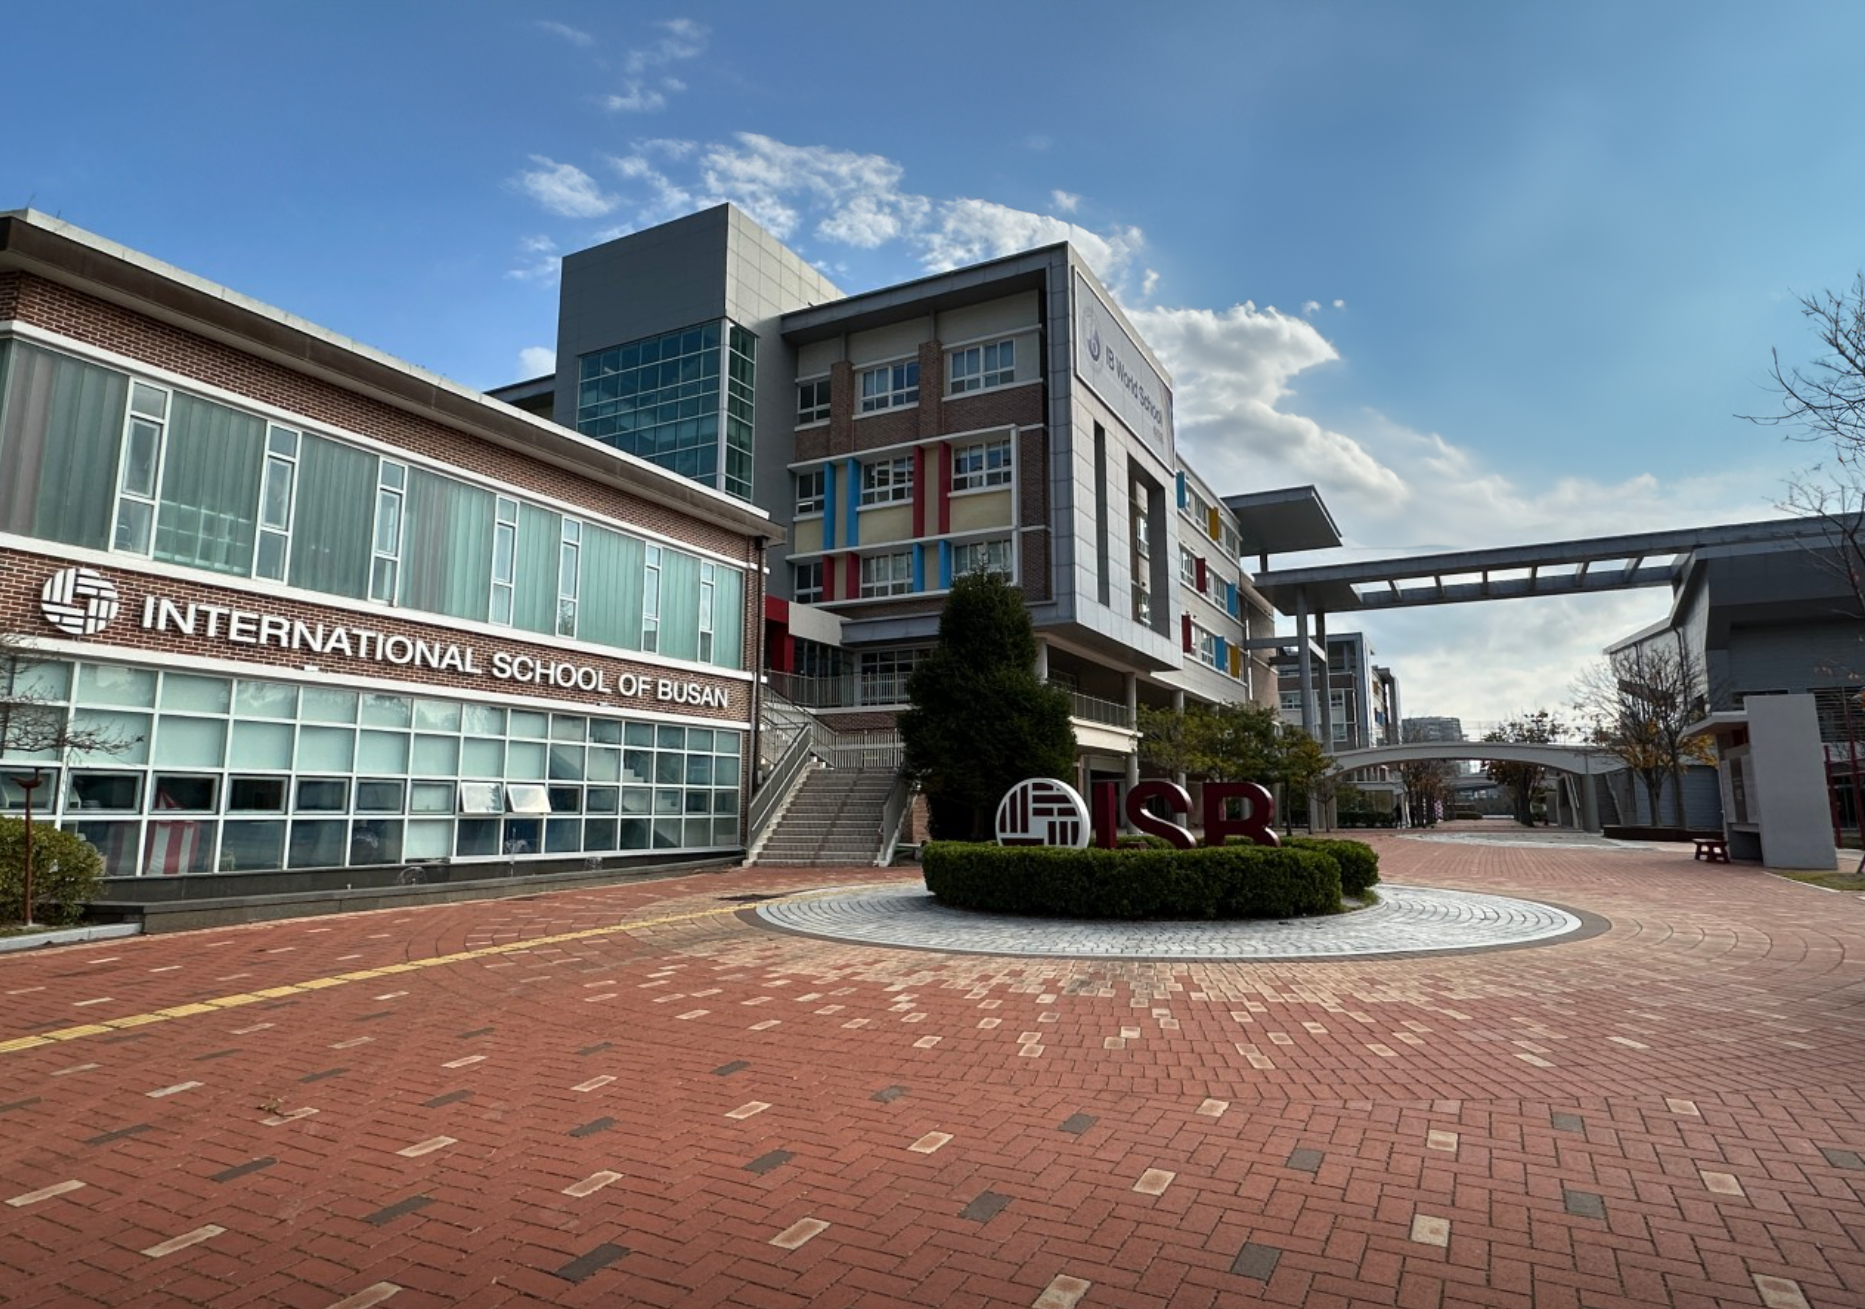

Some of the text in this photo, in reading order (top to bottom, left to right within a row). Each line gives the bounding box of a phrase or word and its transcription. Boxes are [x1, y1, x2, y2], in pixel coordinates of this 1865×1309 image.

[1105, 344, 1115, 371] IB
[1116, 355, 1138, 400] World
[1138, 386, 1163, 428] School
[142, 595, 728, 708] INTERNATIONAL SCHOOL OF BUSAN
